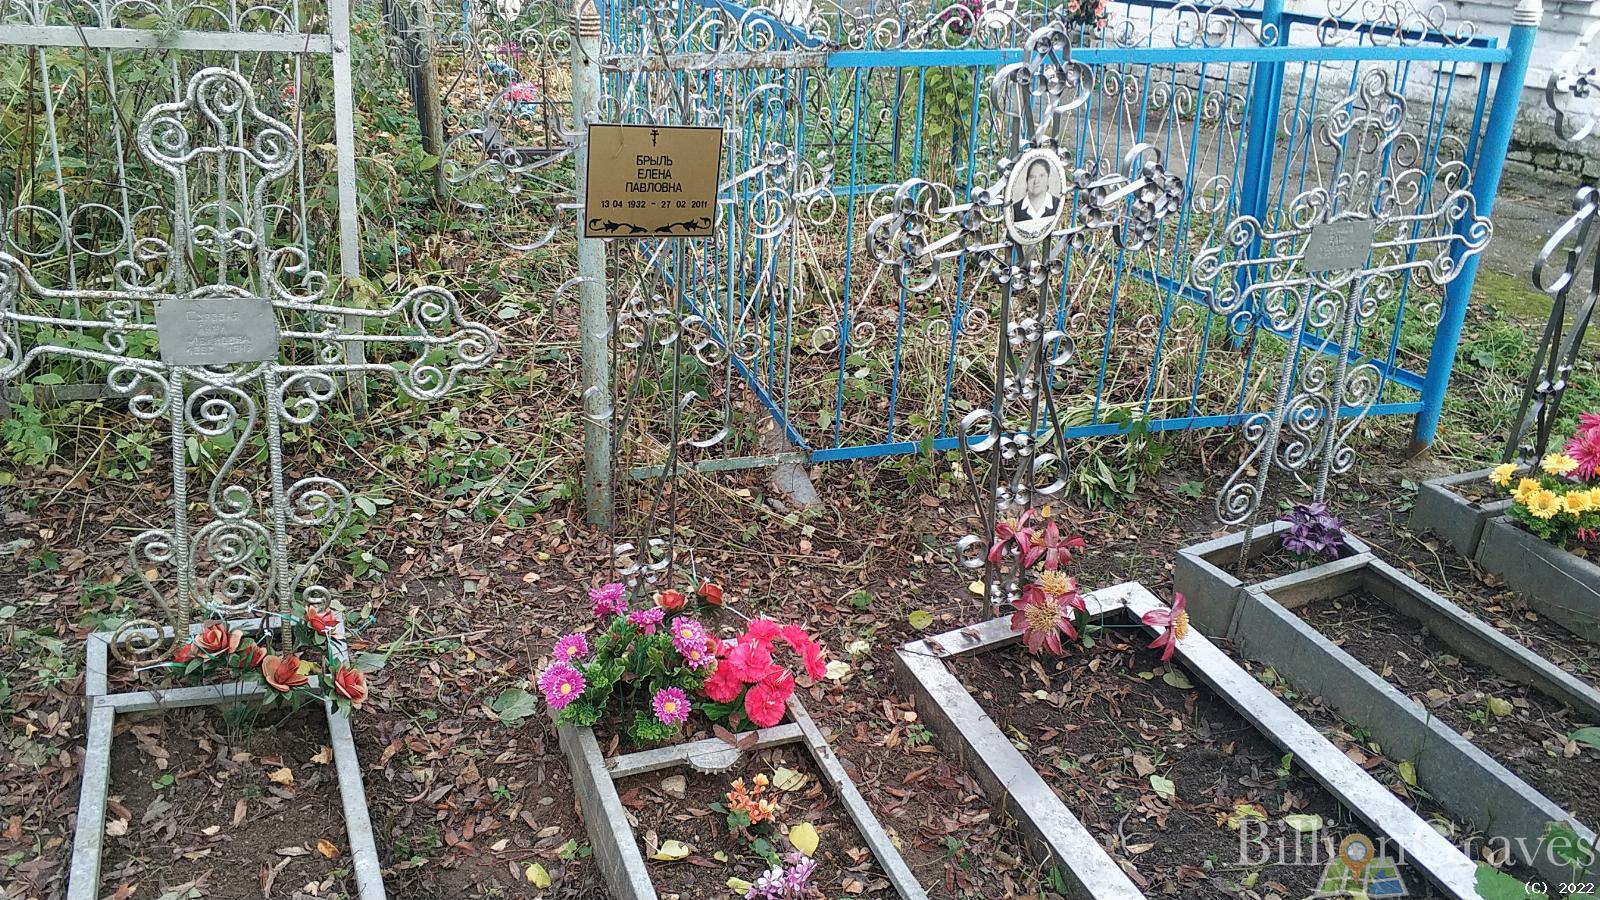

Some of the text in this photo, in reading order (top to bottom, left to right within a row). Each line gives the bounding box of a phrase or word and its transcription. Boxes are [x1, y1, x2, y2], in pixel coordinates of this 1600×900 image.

[636, 155, 673, 166] БРЫЛЬ
[637, 169, 672, 179] ЕЛЕНА
[625, 182, 683, 193] ПАВЛОВНА
[601, 200, 609, 208] 13
[612, 200, 623, 208] 04
